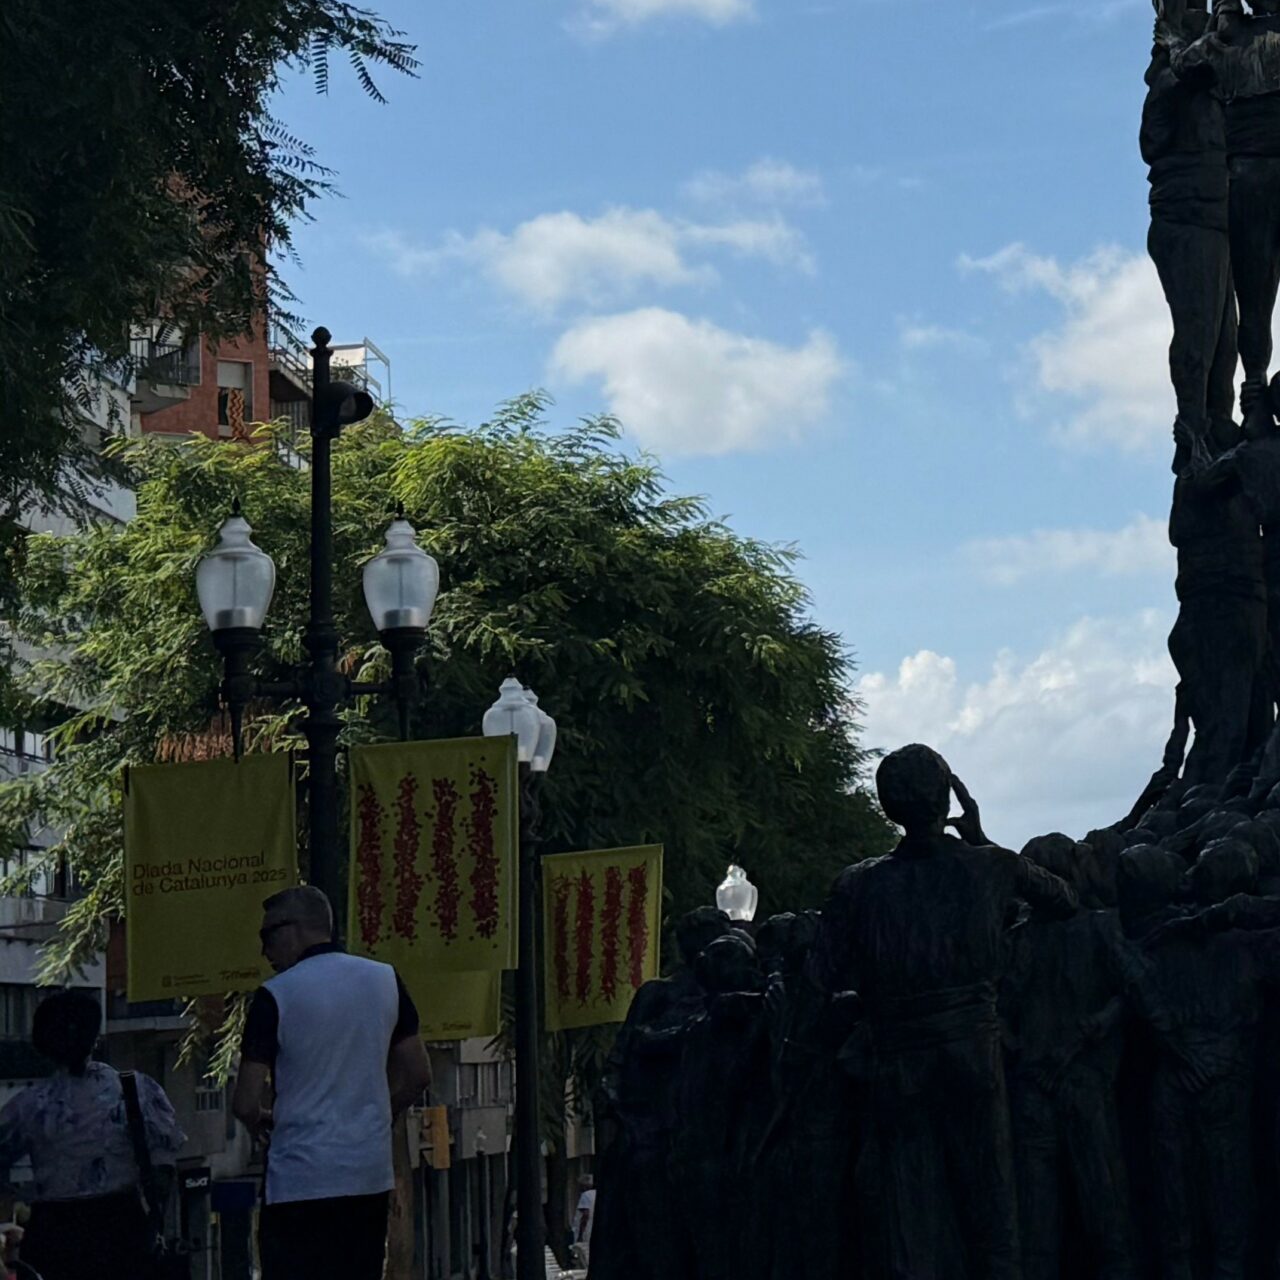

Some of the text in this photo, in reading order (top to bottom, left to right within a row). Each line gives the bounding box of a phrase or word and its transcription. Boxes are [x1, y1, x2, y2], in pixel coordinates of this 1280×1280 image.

[133, 849, 265, 880] Diada Nacional
[132, 869, 288, 896] de Catalunya 2025
